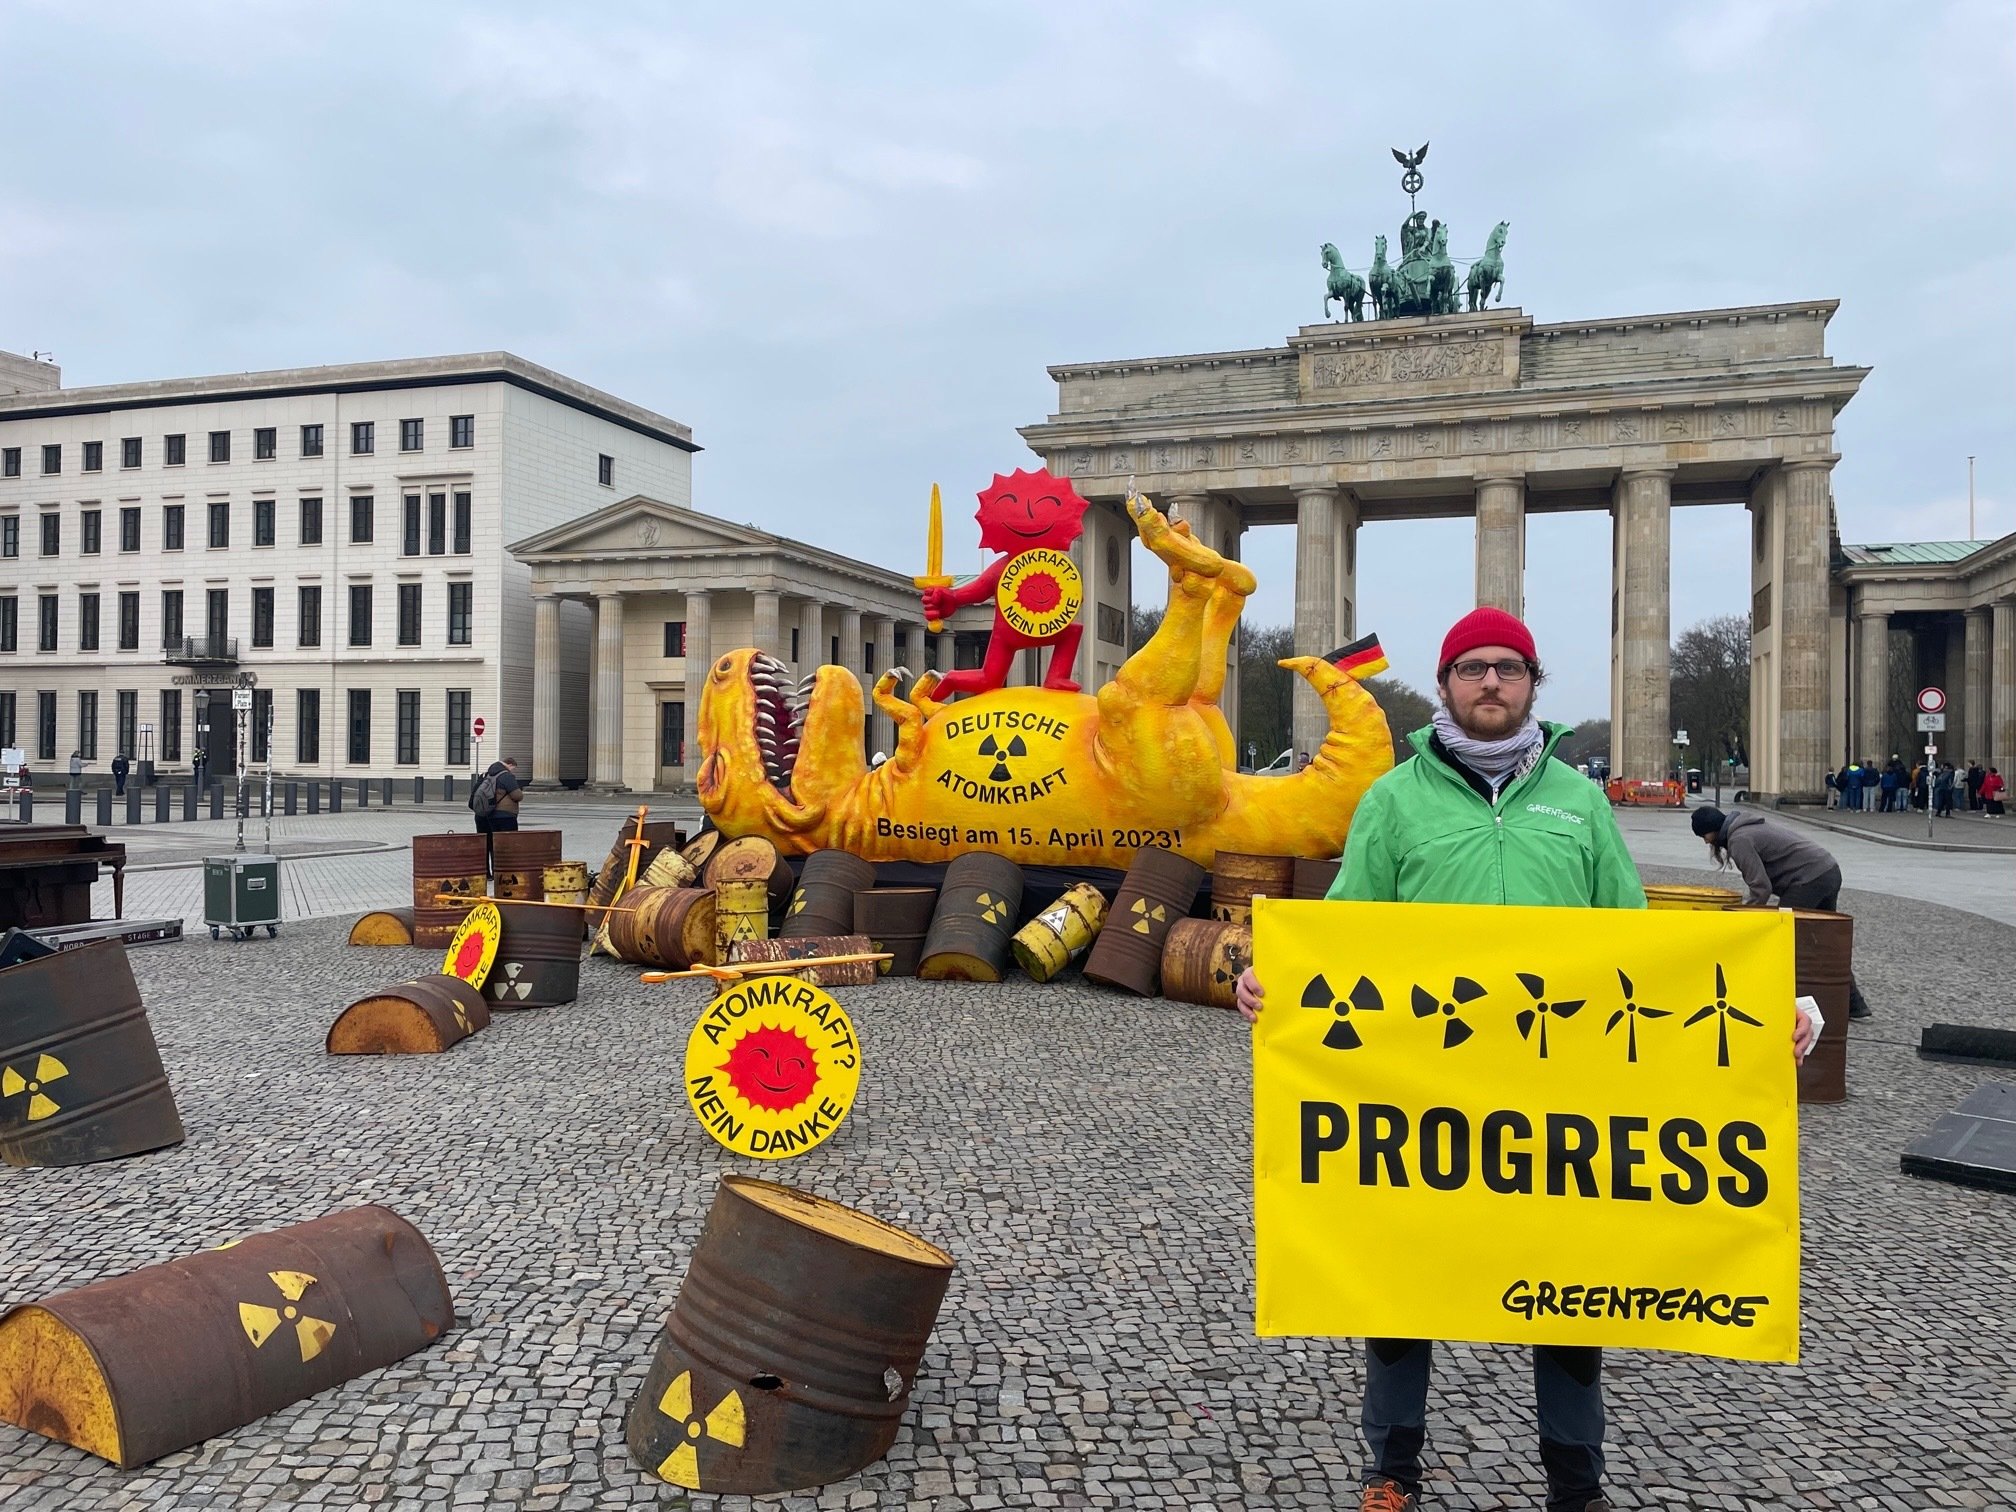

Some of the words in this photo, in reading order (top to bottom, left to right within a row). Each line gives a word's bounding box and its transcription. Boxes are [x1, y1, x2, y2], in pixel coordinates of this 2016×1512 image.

[1001, 550, 1078, 591] ATOMKRAFT?
[1003, 605, 1035, 634] NEIN
[1038, 597, 1079, 635] DANKE
[171, 674, 246, 685] COMMERZBAN
[945, 711, 1070, 741] DEUTSCHE
[936, 767, 1069, 805] ATOMKRAFT
[1526, 803, 1585, 825] GREENPEACE
[876, 817, 958, 846] Besiegt
[965, 828, 999, 845] am
[1007, 827, 1040, 846] 15.
[1048, 828, 1103, 850] April
[1111, 829, 1183, 849] 2023!
[128, 932, 151, 941] STAGE
[451, 906, 498, 955] ATOMKRAFT?
[702, 981, 856, 1069] ATOMKRAFT?
[690, 1075, 745, 1142] NEIN
[749, 1096, 844, 1154] DANKE
[1300, 1100, 1769, 1208] PROGRESS
[1501, 1279, 1770, 1328] GREENPEACE
